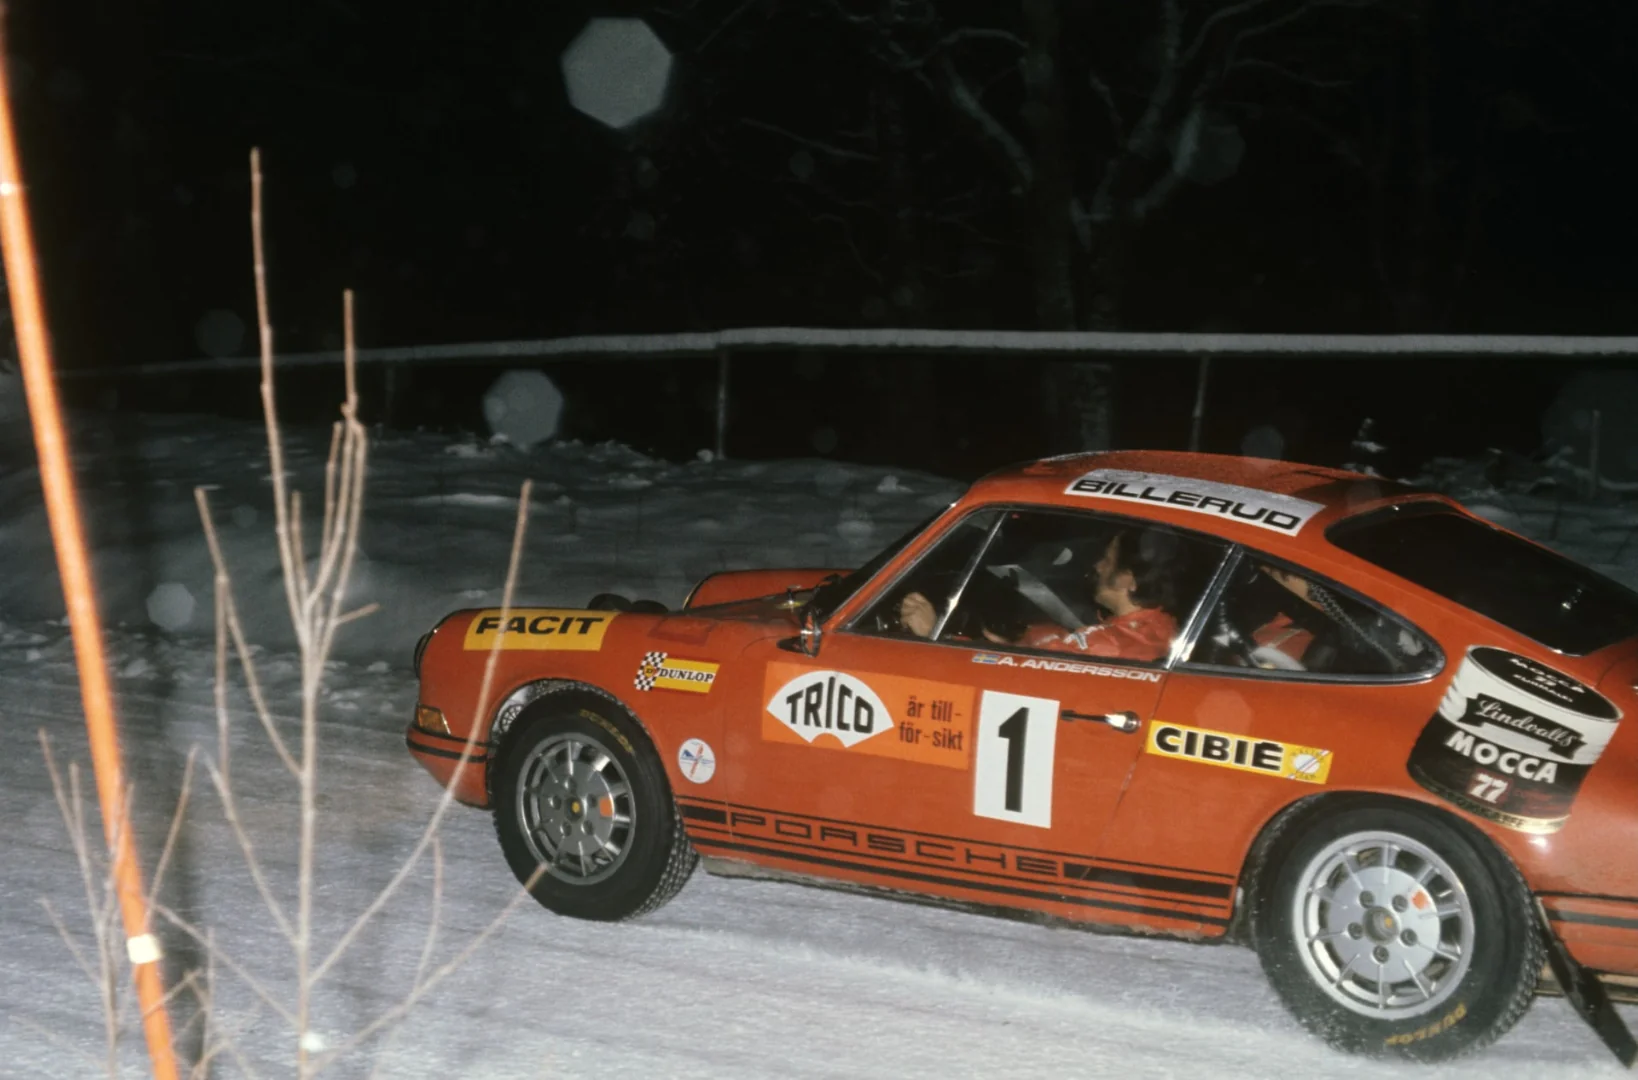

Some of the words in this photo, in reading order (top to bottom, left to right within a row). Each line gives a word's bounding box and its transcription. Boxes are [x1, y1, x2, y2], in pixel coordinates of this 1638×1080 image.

[1071, 479, 1302, 531] BILLERUD
[475, 616, 603, 634] FACIT
[659, 668, 714, 683] DUNLOP
[998, 656, 1018, 667] A.
[1021, 659, 1162, 682] ANDERSSON
[786, 676, 874, 734] TRICO
[906, 694, 925, 719] är
[931, 700, 962, 723] till-
[899, 722, 964, 752] för-sikt
[998, 707, 1029, 813] 1
[1446, 730, 1558, 784] MOCCA
[1468, 772, 1508, 804] 77
[730, 812, 1059, 876] PORSCHE
